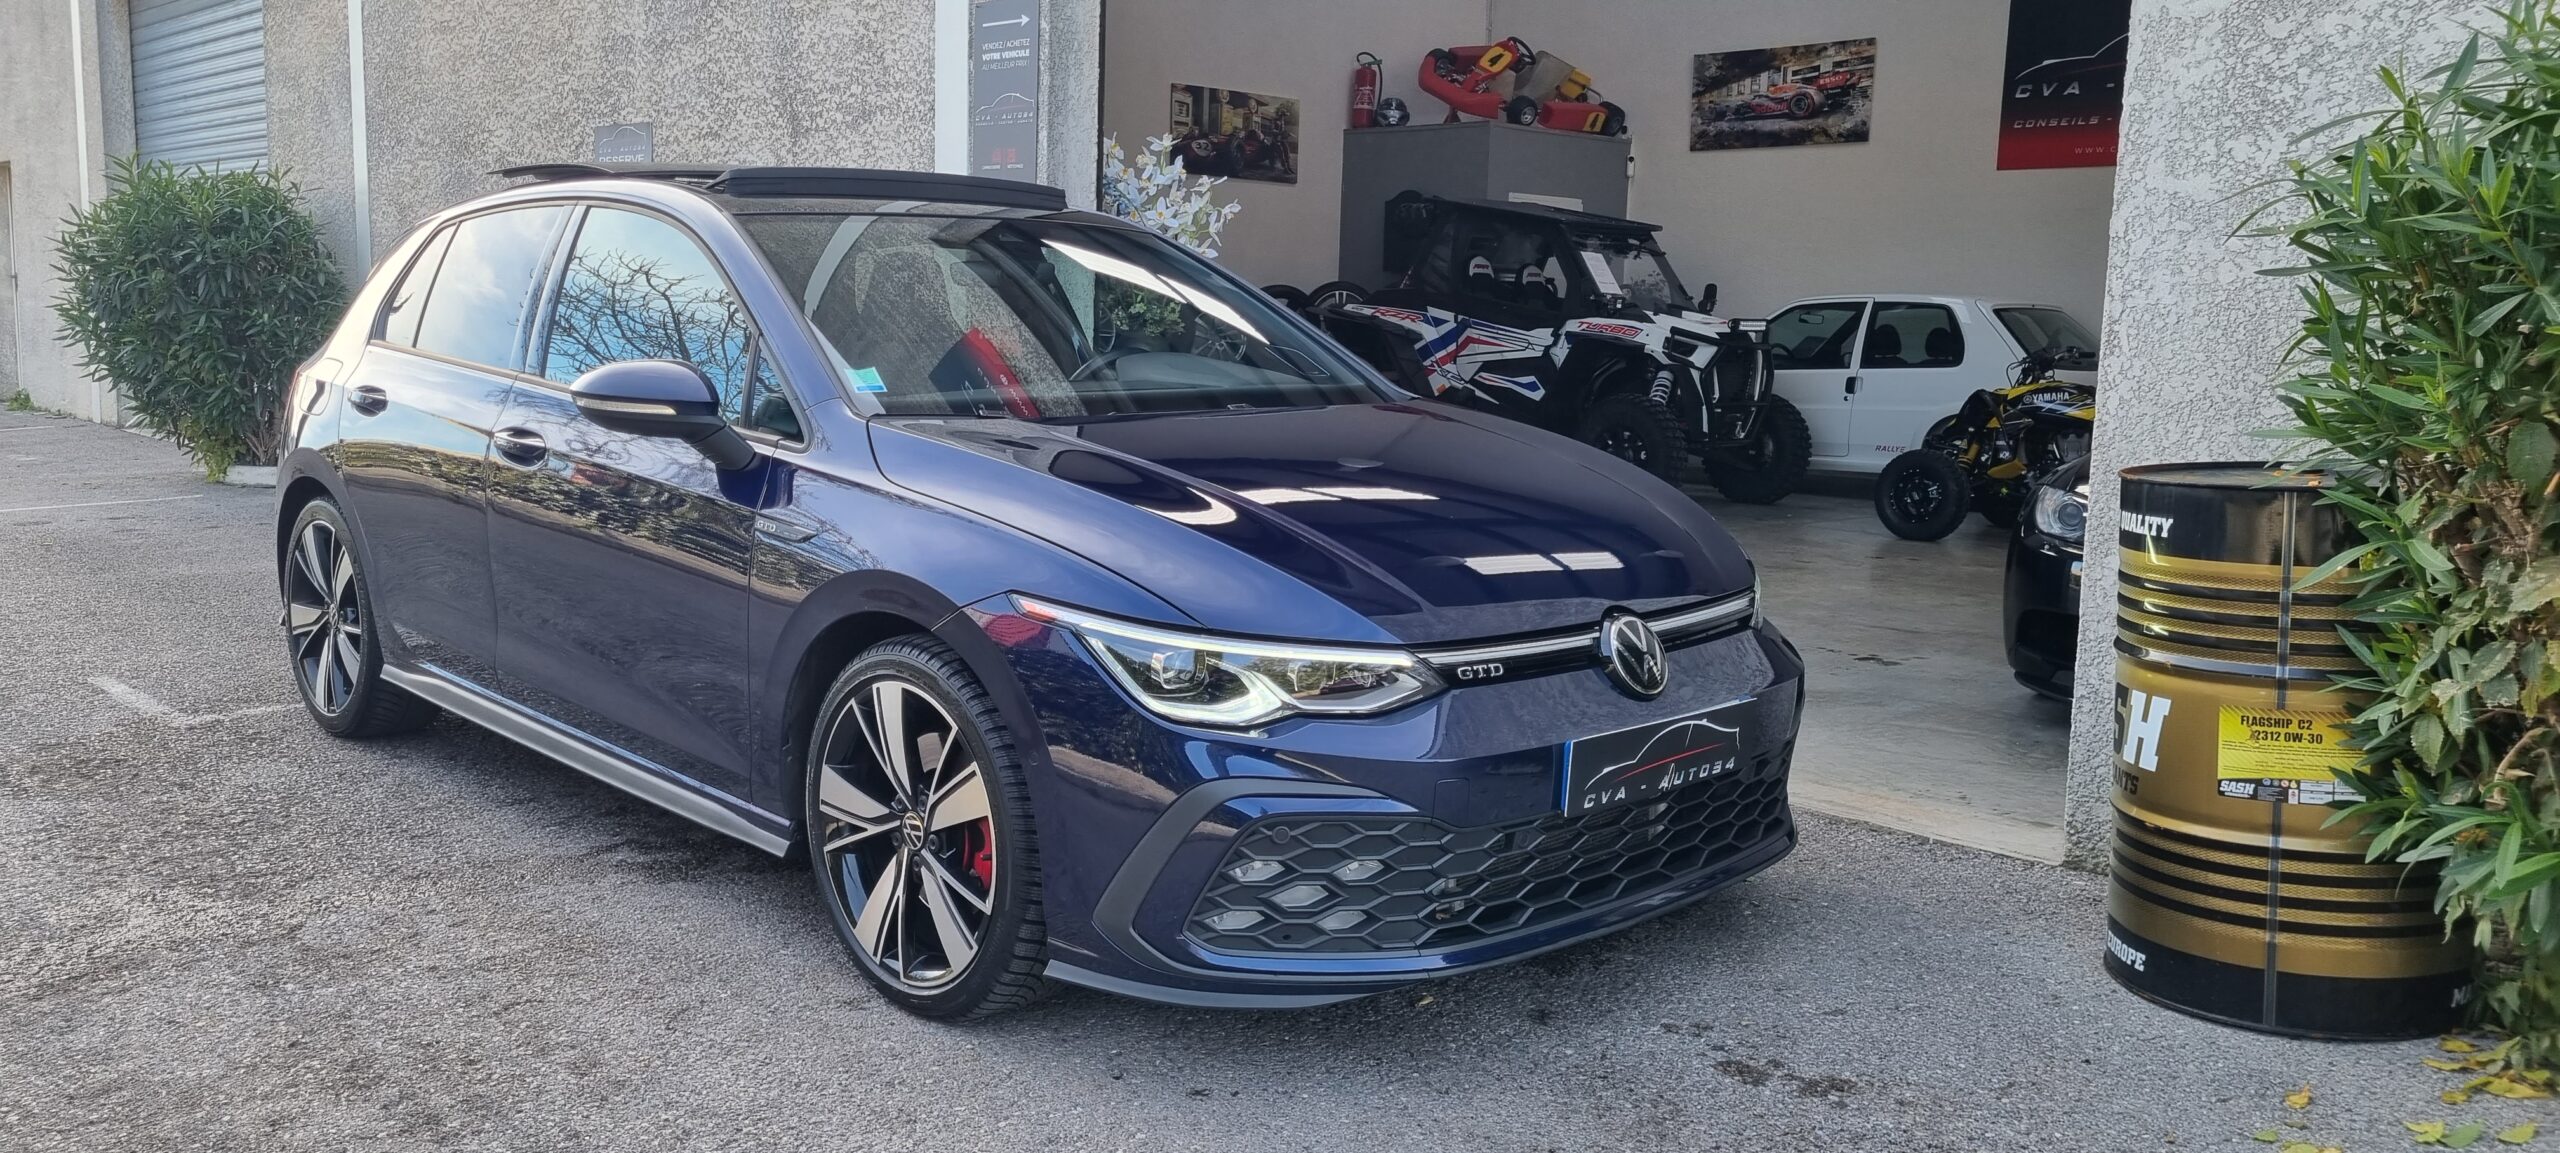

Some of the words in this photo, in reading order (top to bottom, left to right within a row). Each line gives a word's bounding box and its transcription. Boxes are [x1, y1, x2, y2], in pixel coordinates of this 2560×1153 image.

[2014, 81, 2080, 98] CVA
[2013, 116, 2100, 128] CONSEILS
[1577, 321, 1640, 337] TURBO
[2032, 391, 2070, 403] YAMAHA
[1875, 444, 1907, 453] RALLYE
[757, 520, 776, 532] GTD
[1457, 662, 1504, 680] GTD
[2240, 715, 2293, 729] FLAGSHIP
[2297, 719, 2313, 731] C2
[2284, 732, 2323, 745] 0W-30
[2219, 780, 2256, 795] SASH
[1583, 786, 1626, 809] CVA
